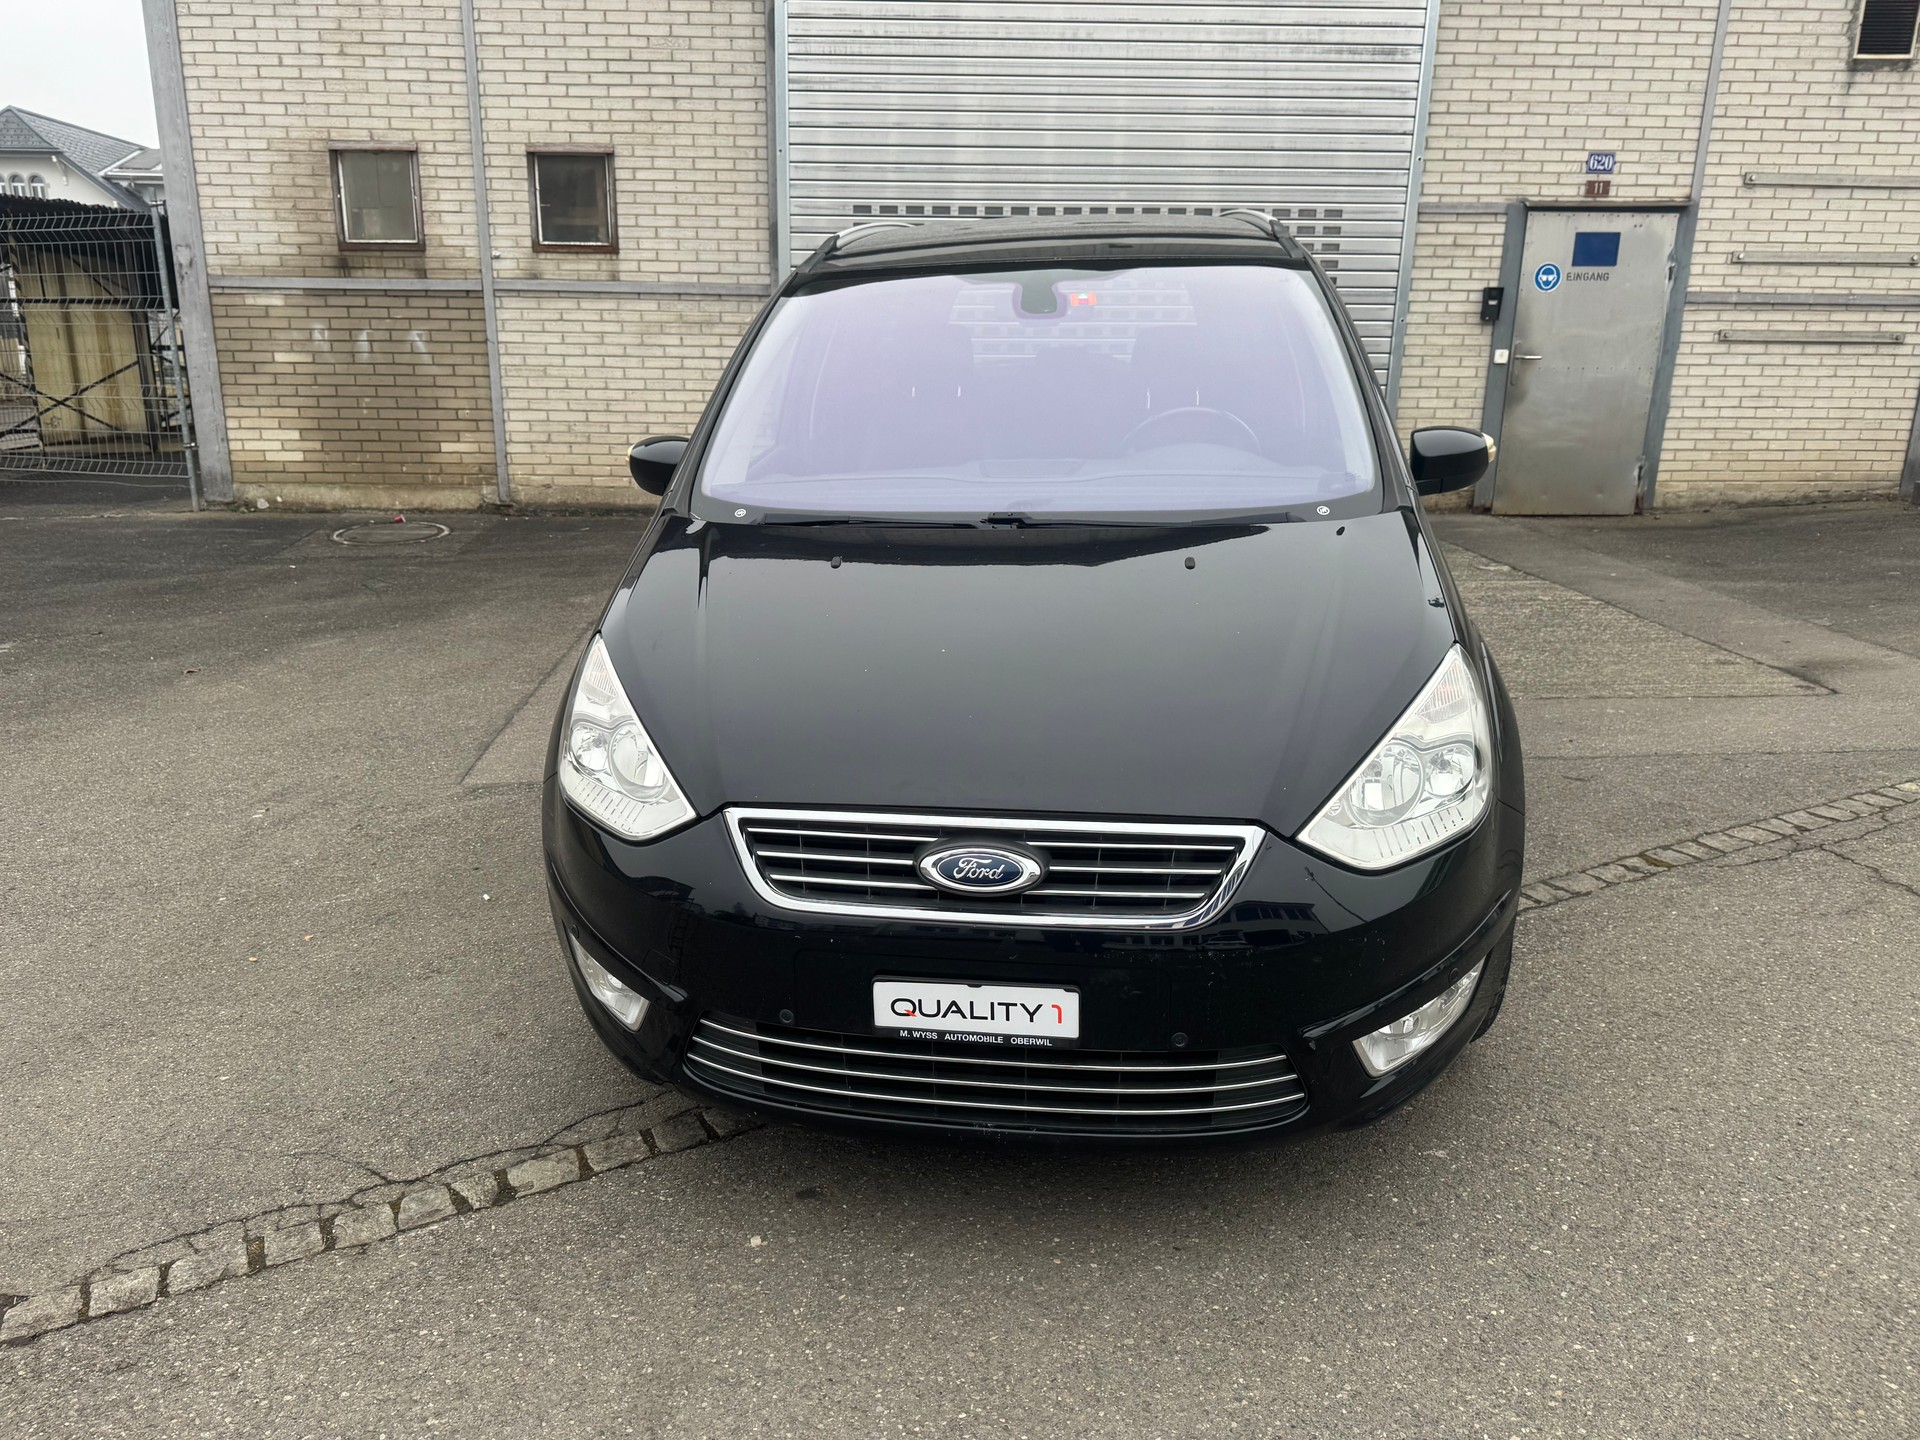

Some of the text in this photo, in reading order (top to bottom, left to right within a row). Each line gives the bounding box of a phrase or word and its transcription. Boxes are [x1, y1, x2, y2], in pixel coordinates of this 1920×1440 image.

[1590, 154, 1614, 170] 620
[1593, 182, 1604, 194] 11
[1566, 272, 1610, 282] EINGANG
[953, 857, 1005, 879] Ford
[899, 1030, 1053, 1047] M. WYSS AUTOMOBILE OBERWIL
